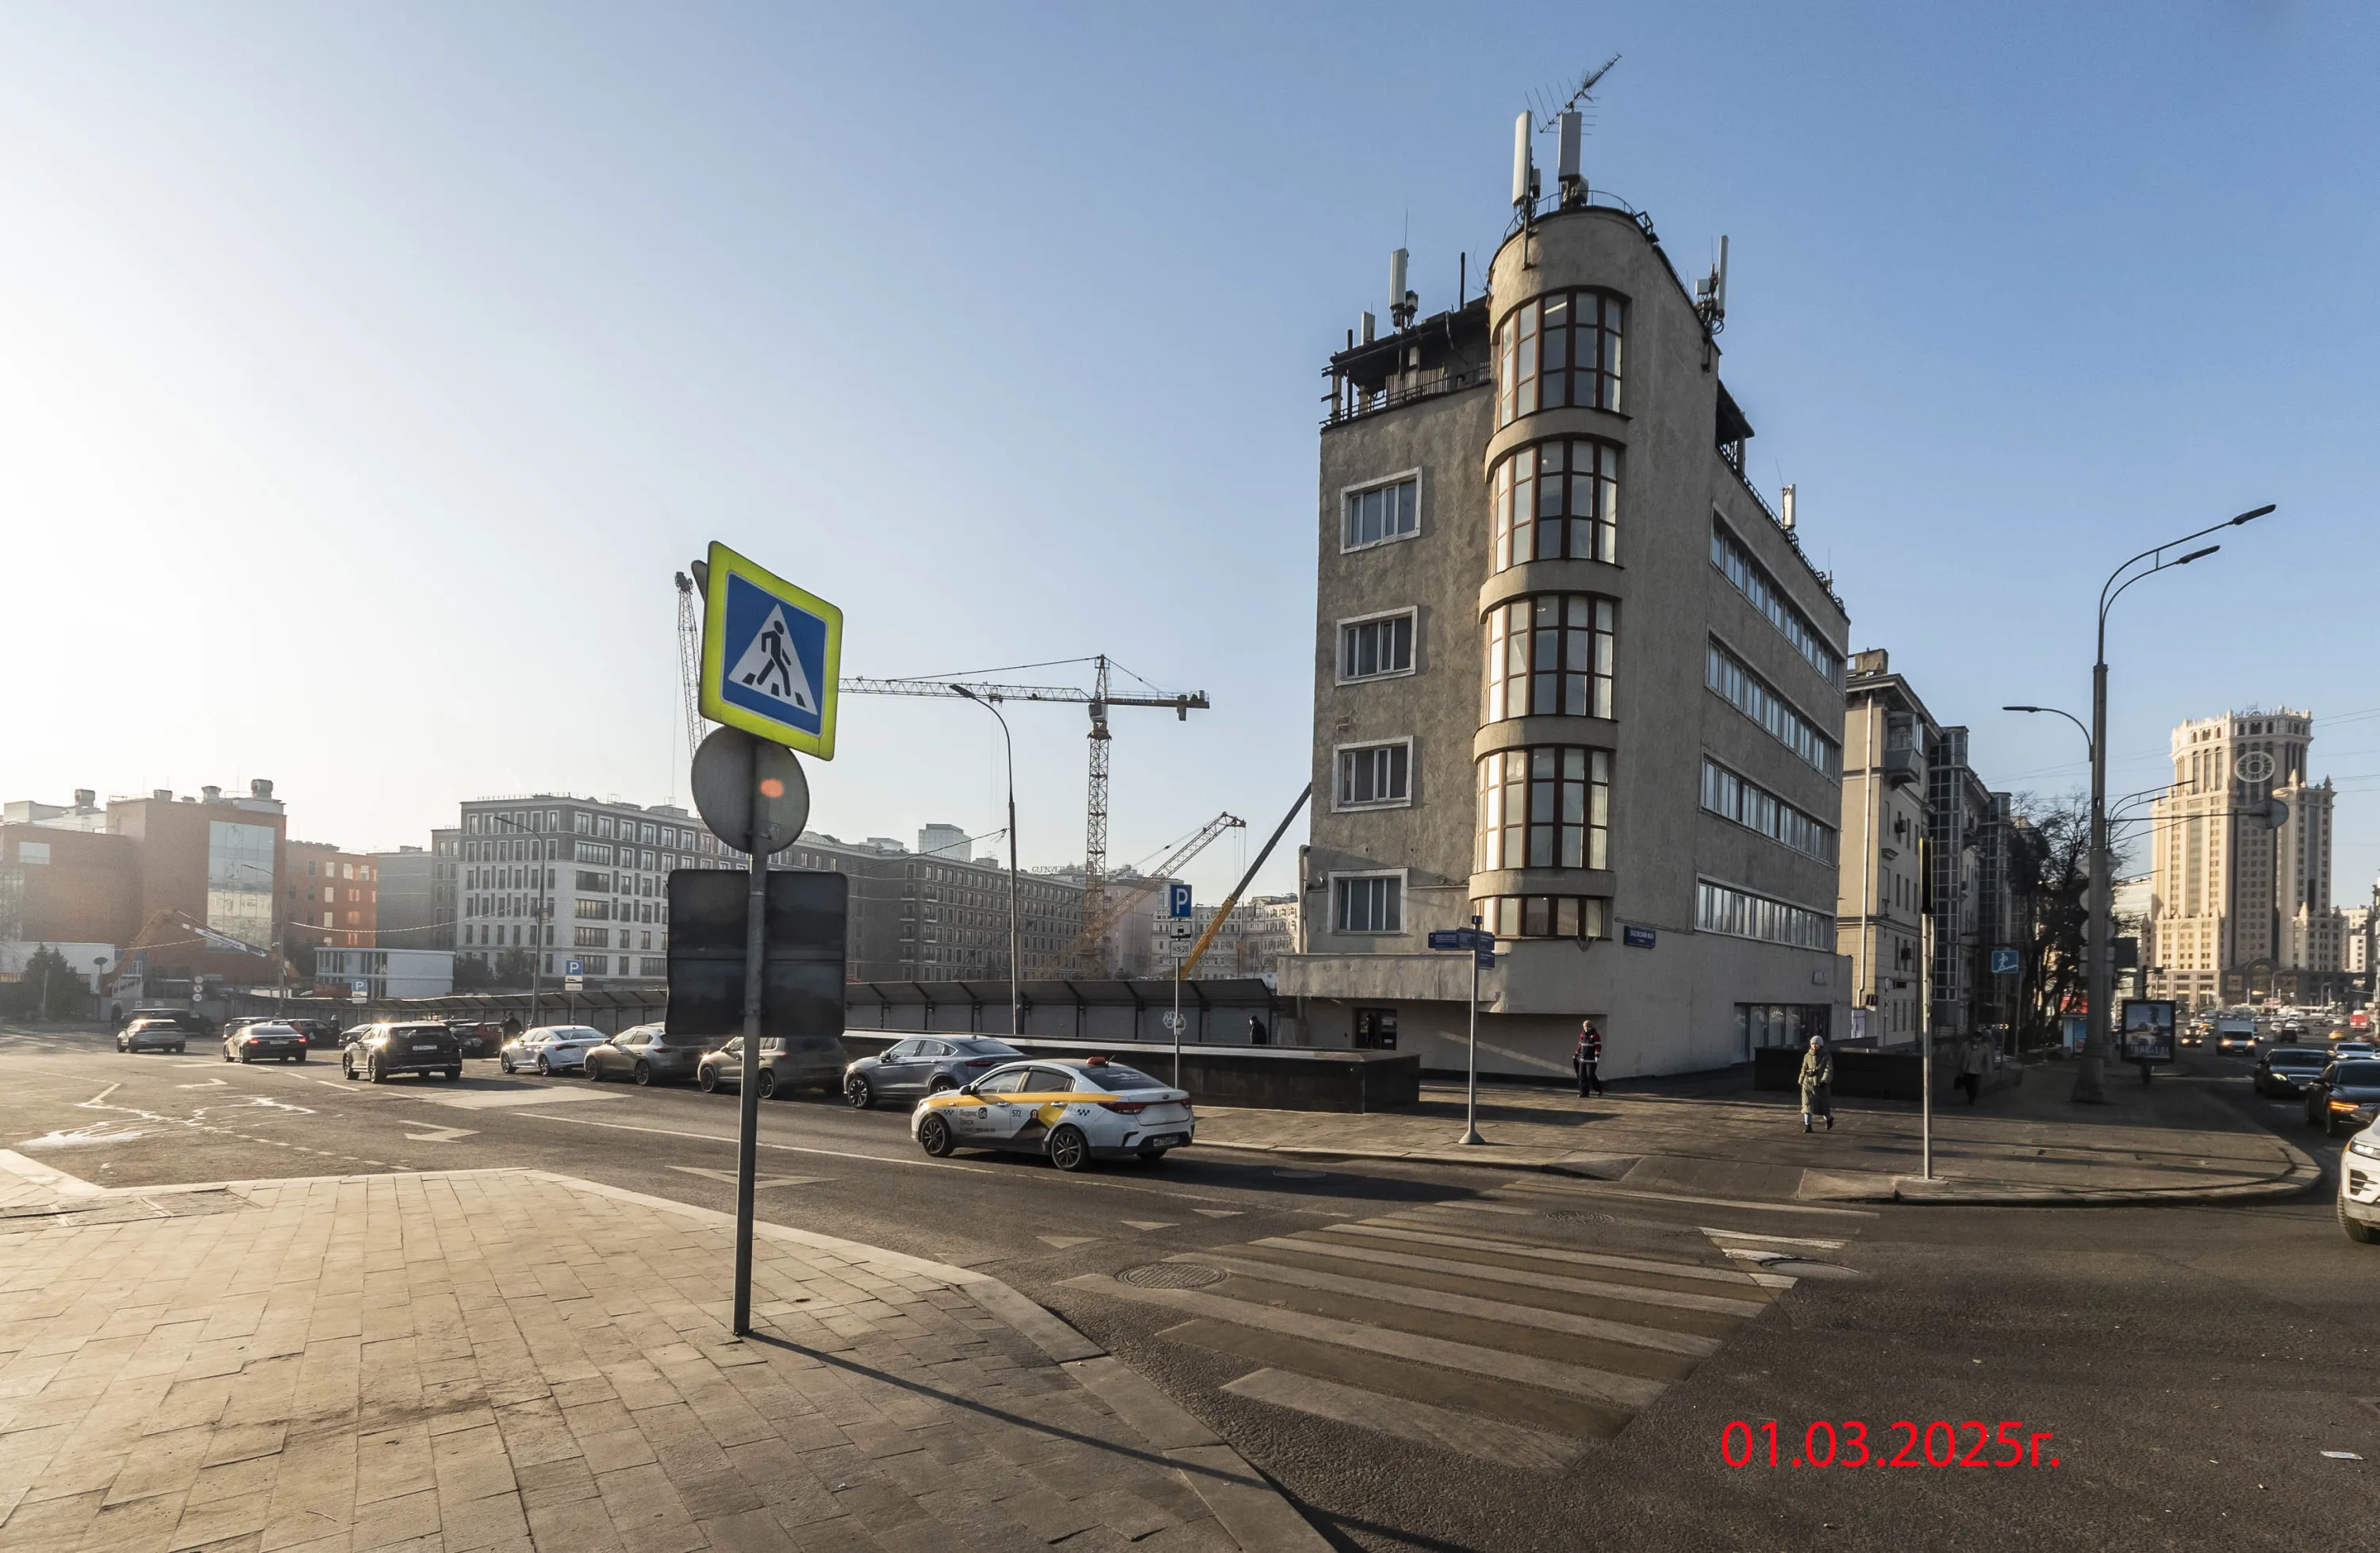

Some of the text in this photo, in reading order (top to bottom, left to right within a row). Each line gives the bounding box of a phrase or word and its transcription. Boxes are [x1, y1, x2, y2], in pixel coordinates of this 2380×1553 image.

[1177, 888, 1188, 914] P
[570, 962, 579, 973] P
[356, 981, 364, 990] P
